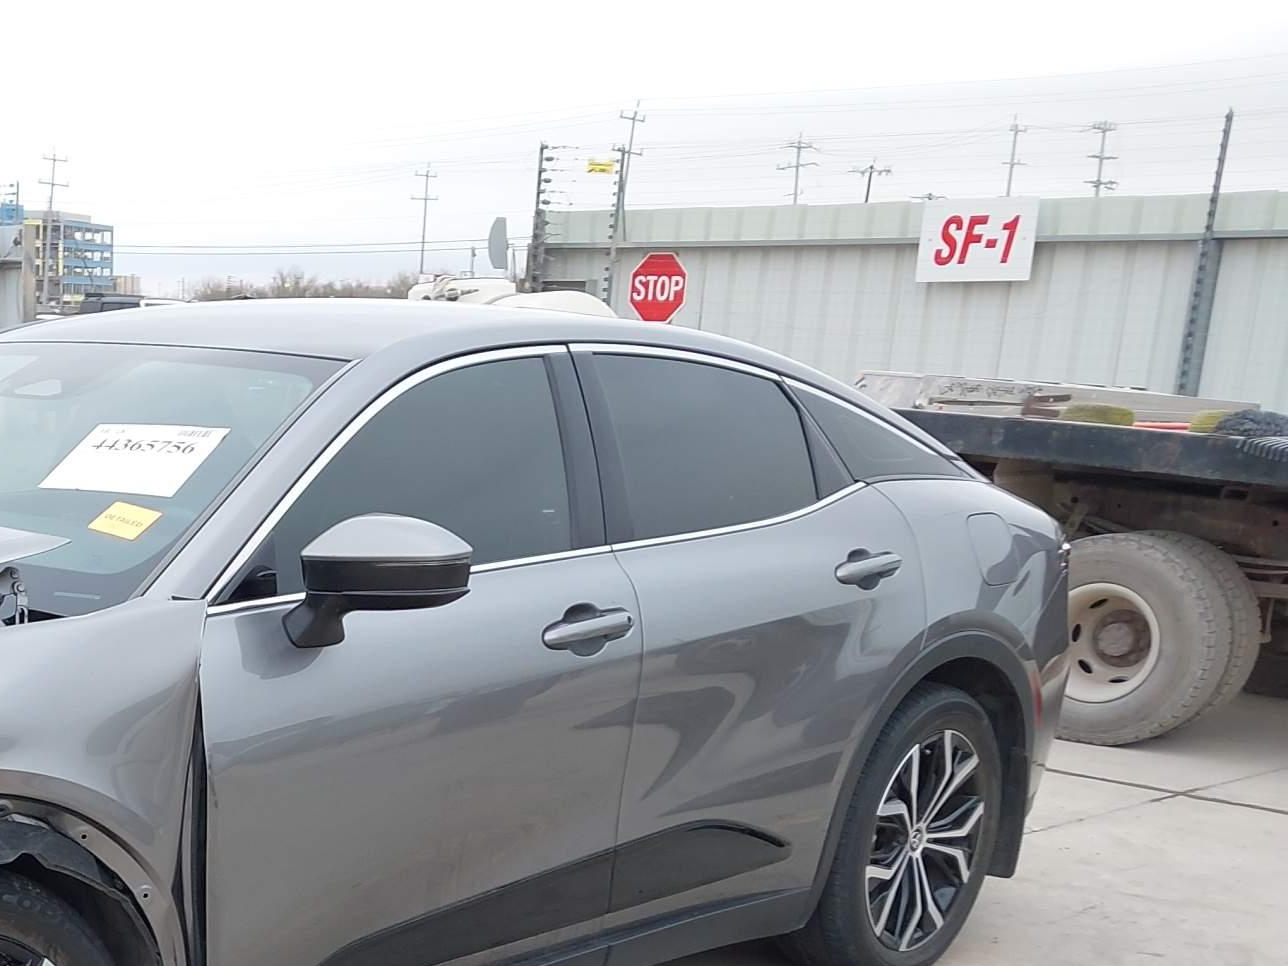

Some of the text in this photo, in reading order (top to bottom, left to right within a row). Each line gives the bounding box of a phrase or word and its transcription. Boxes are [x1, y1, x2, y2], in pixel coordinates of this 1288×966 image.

[933, 214, 1021, 266] SF-1
[632, 275, 684, 301] STOP
[91, 438, 197, 455] 44365756
